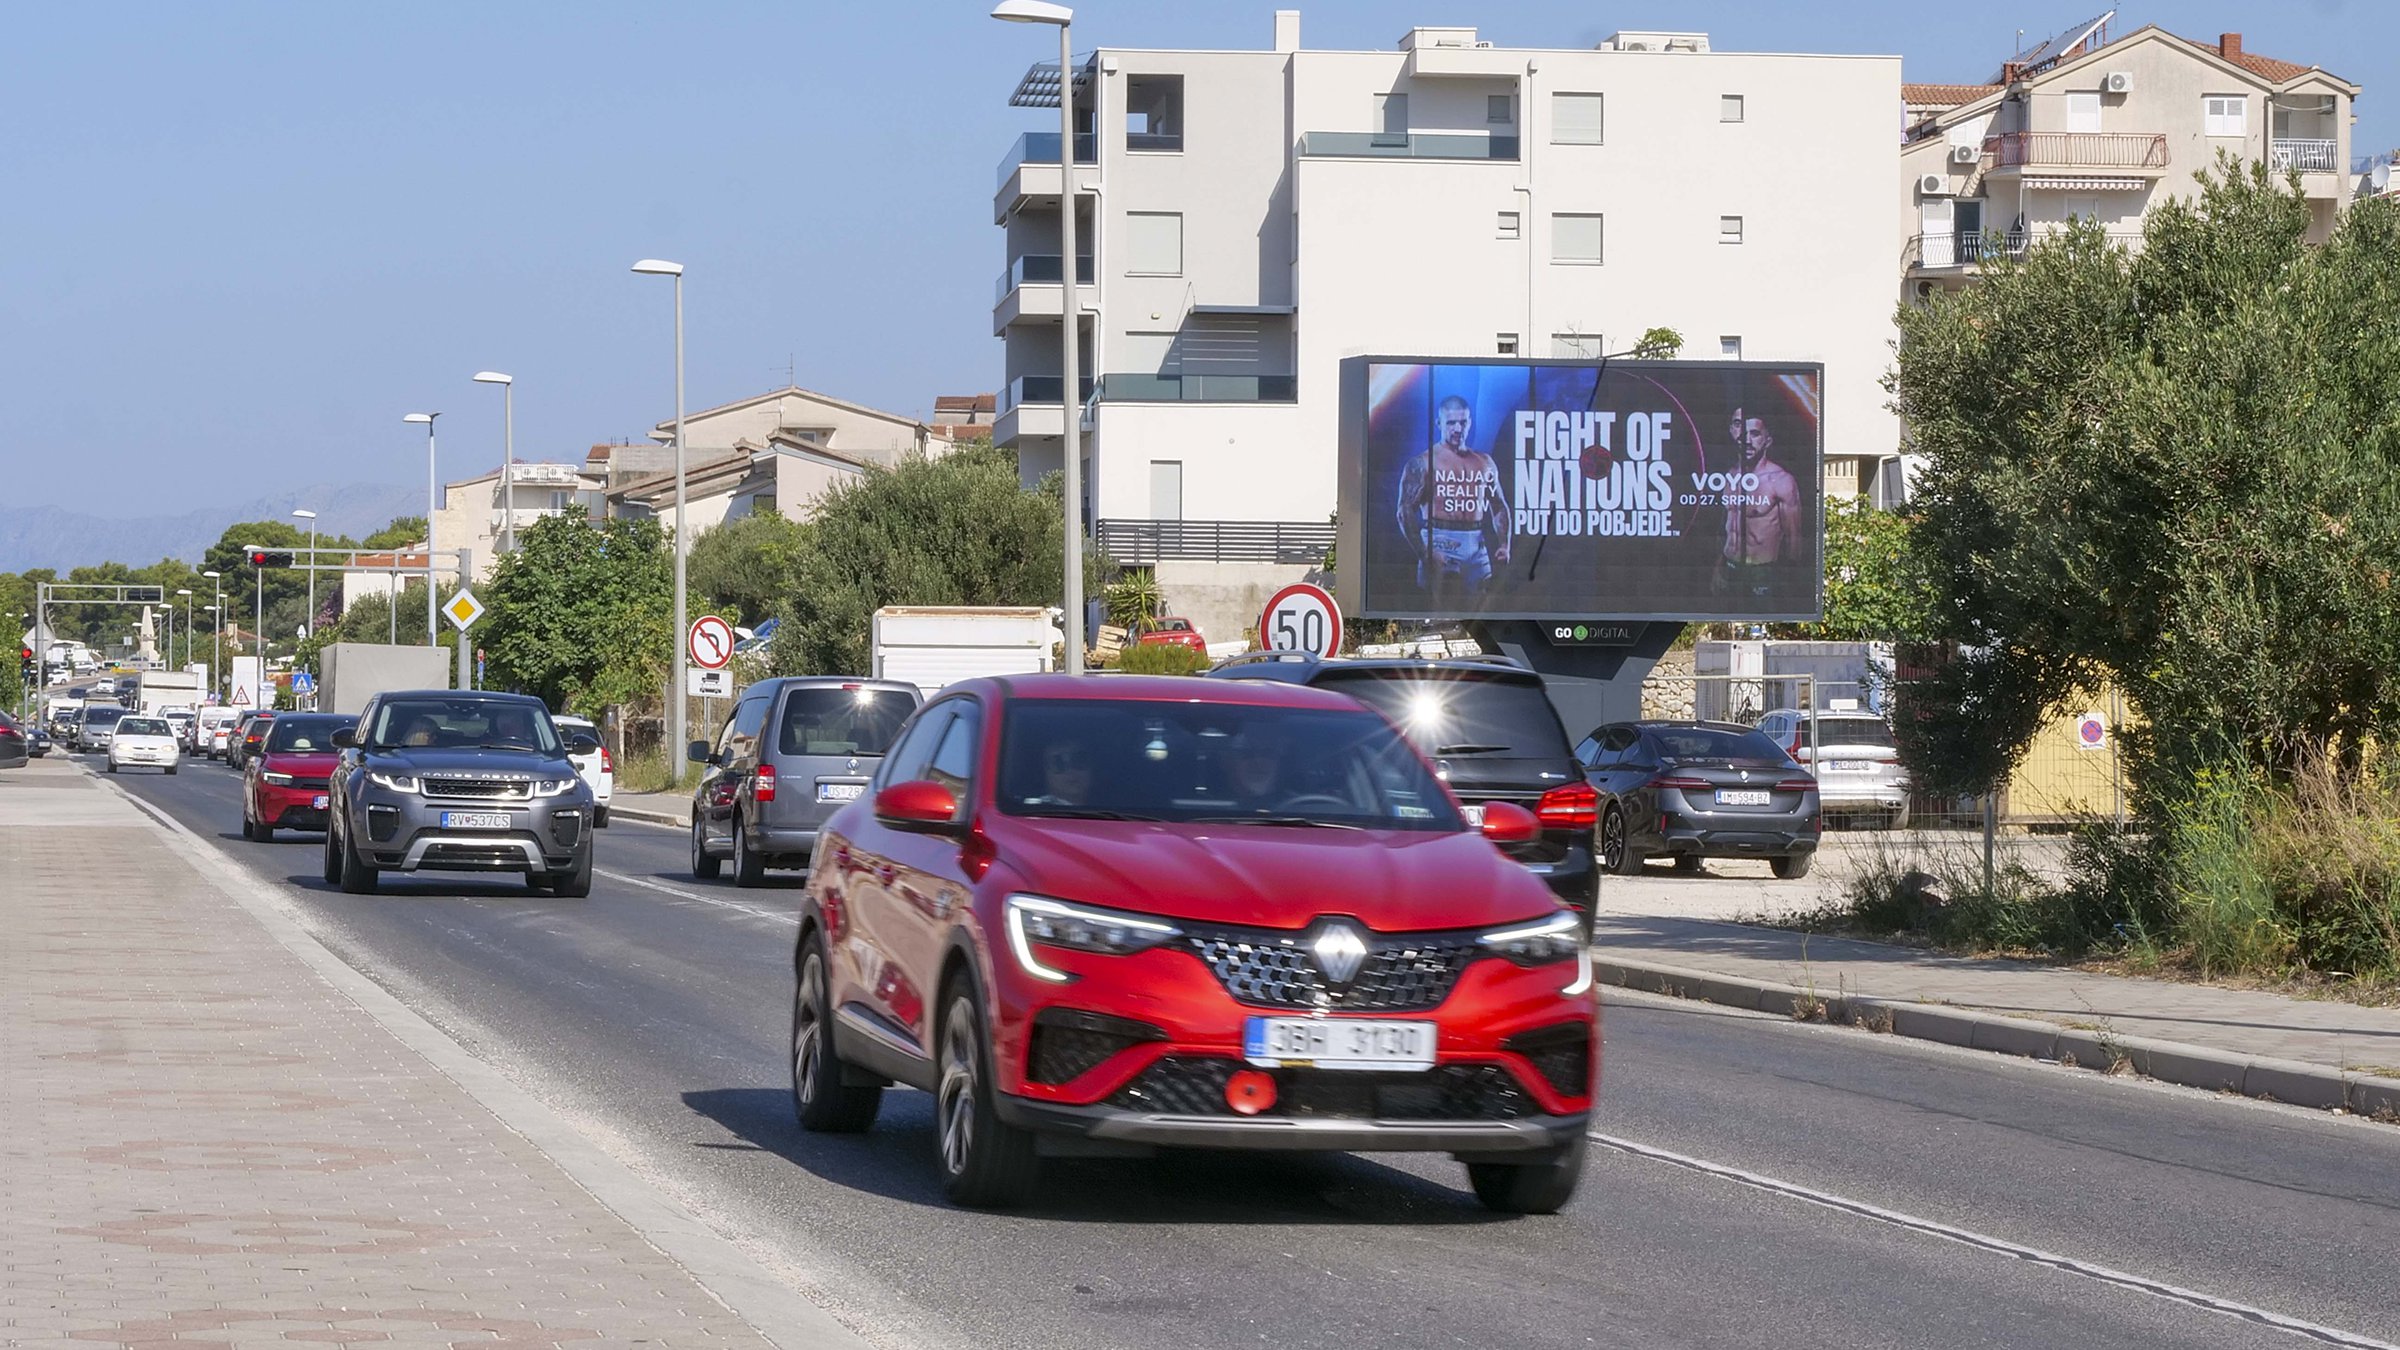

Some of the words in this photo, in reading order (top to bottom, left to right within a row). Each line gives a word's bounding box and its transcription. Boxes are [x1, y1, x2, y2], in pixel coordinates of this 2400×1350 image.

[1515, 411, 1617, 459] FIGHT
[1626, 412, 1672, 460] OF
[1437, 484, 1497, 497] REALITY
[1514, 459, 1672, 510] NATIONS
[1691, 472, 1760, 492] VOYO
[1444, 498, 1490, 512] SHOW
[1680, 494, 1697, 506] OD
[1700, 494, 1719, 506] 27.
[1721, 494, 1770, 506] SRPNJA
[1514, 510, 1550, 535] PUT
[1555, 510, 1582, 536] DO
[1587, 510, 1672, 536] POBJEDE
[1277, 608, 1323, 657] 50
[1555, 627, 1572, 639] GO
[1589, 627, 1632, 639] DIGITAL
